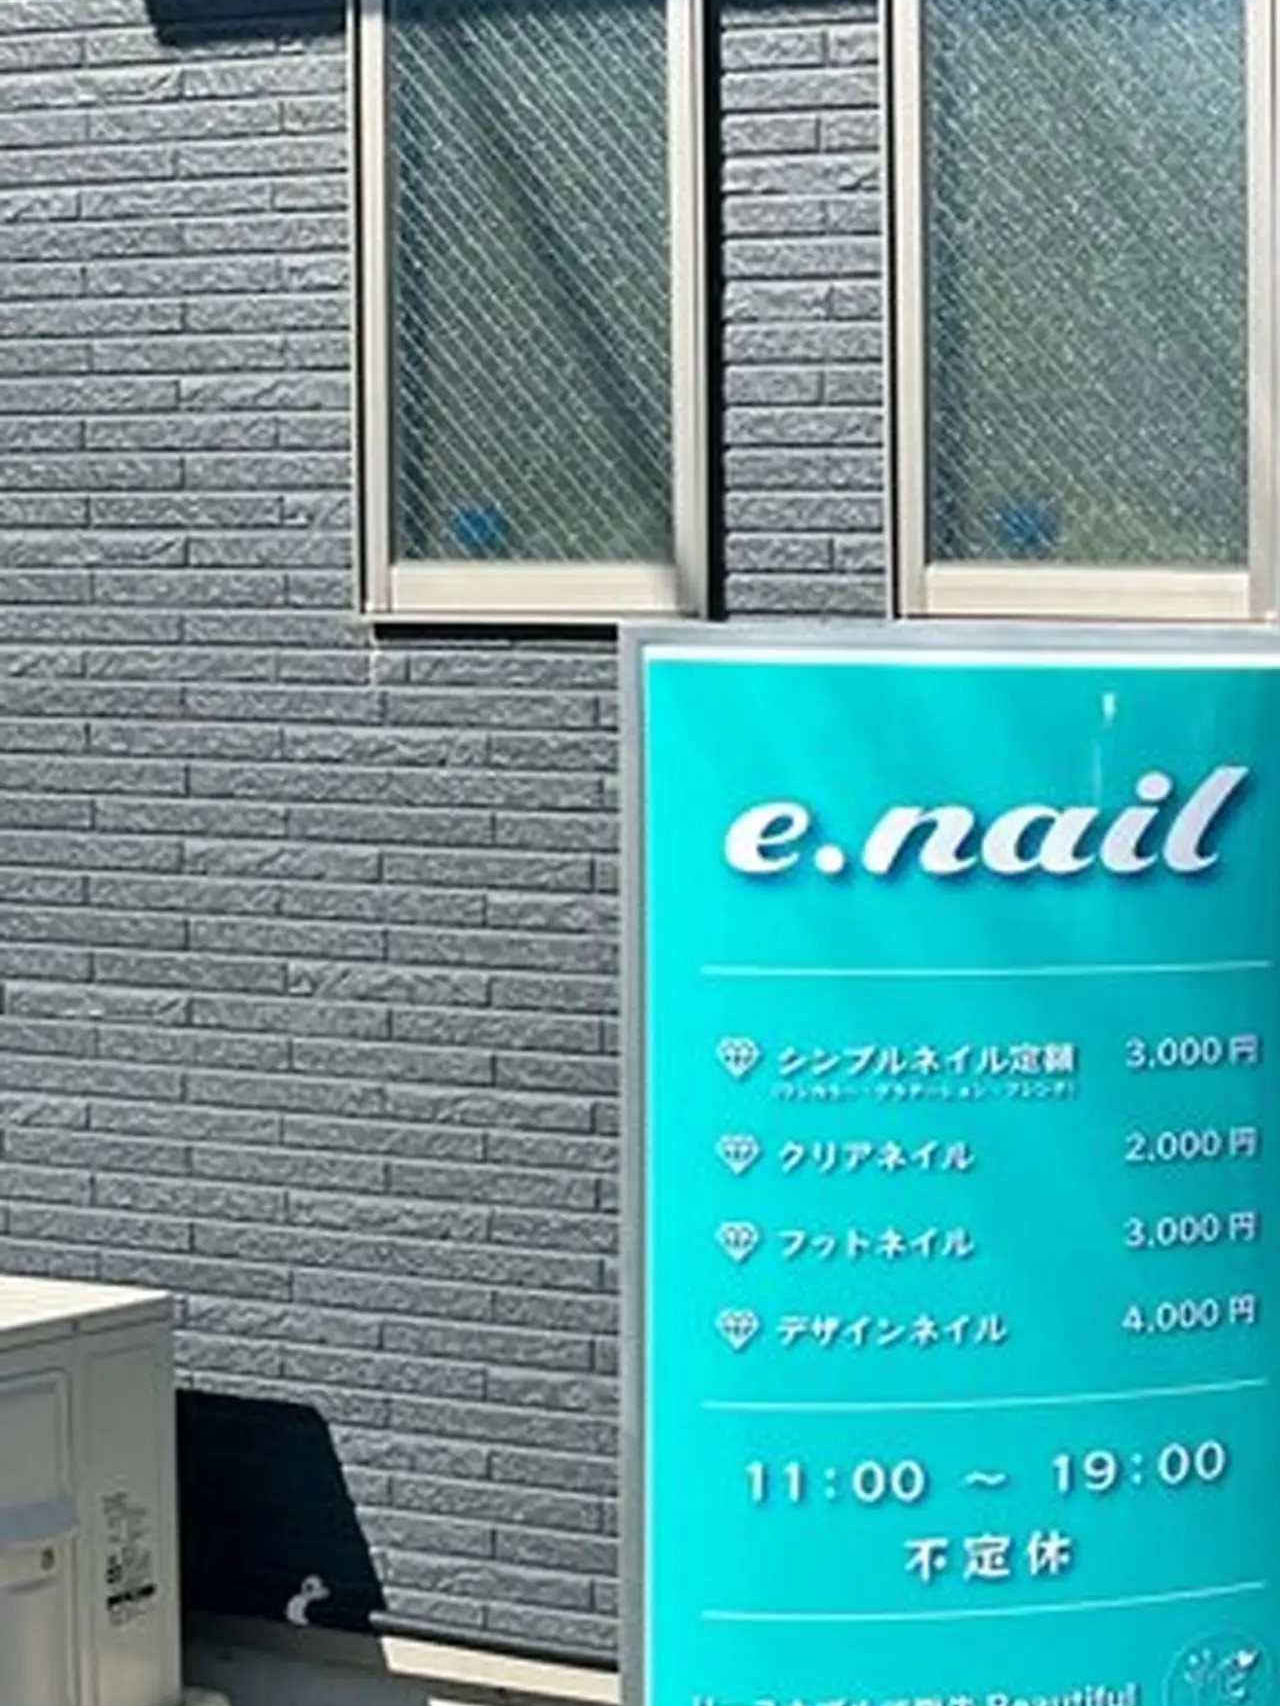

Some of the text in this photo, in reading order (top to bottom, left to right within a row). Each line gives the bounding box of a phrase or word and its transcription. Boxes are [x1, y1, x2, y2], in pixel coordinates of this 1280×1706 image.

[724, 765, 1249, 875] e.nail
[777, 1140, 974, 1172] クリアネイル
[778, 1226, 974, 1259] フットネイル
[776, 1313, 1007, 1348] デザインネイル
[746, 1459, 926, 1504] 11:00
[1052, 1439, 1227, 1493] 19:00
[904, 1530, 1073, 1582] 不定休
